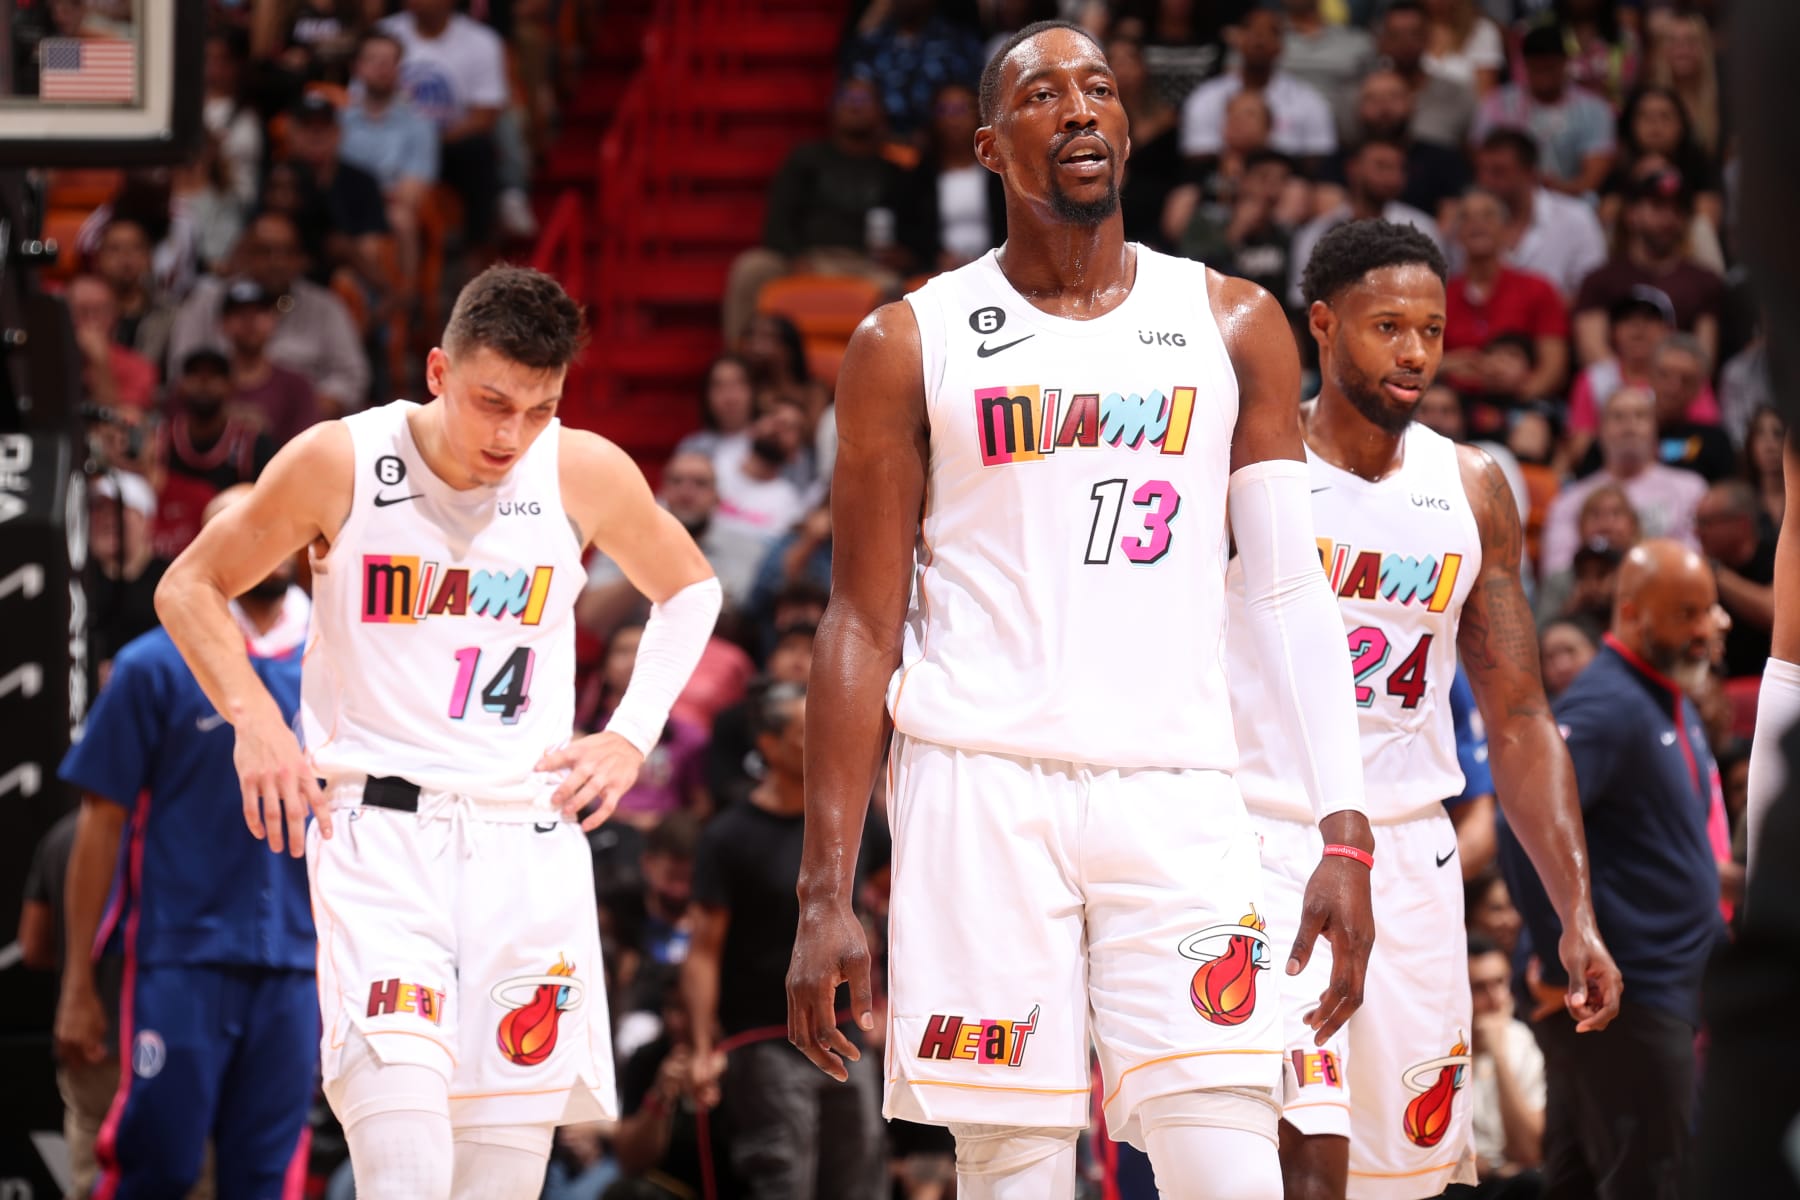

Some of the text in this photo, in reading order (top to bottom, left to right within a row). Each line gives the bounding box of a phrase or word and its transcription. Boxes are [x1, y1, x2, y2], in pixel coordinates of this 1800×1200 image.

[977, 308, 1000, 334] 6
[378, 458, 402, 484] 6
[1084, 479, 1181, 566] 13
[448, 646, 535, 725] 14
[1347, 626, 1434, 709] 24
